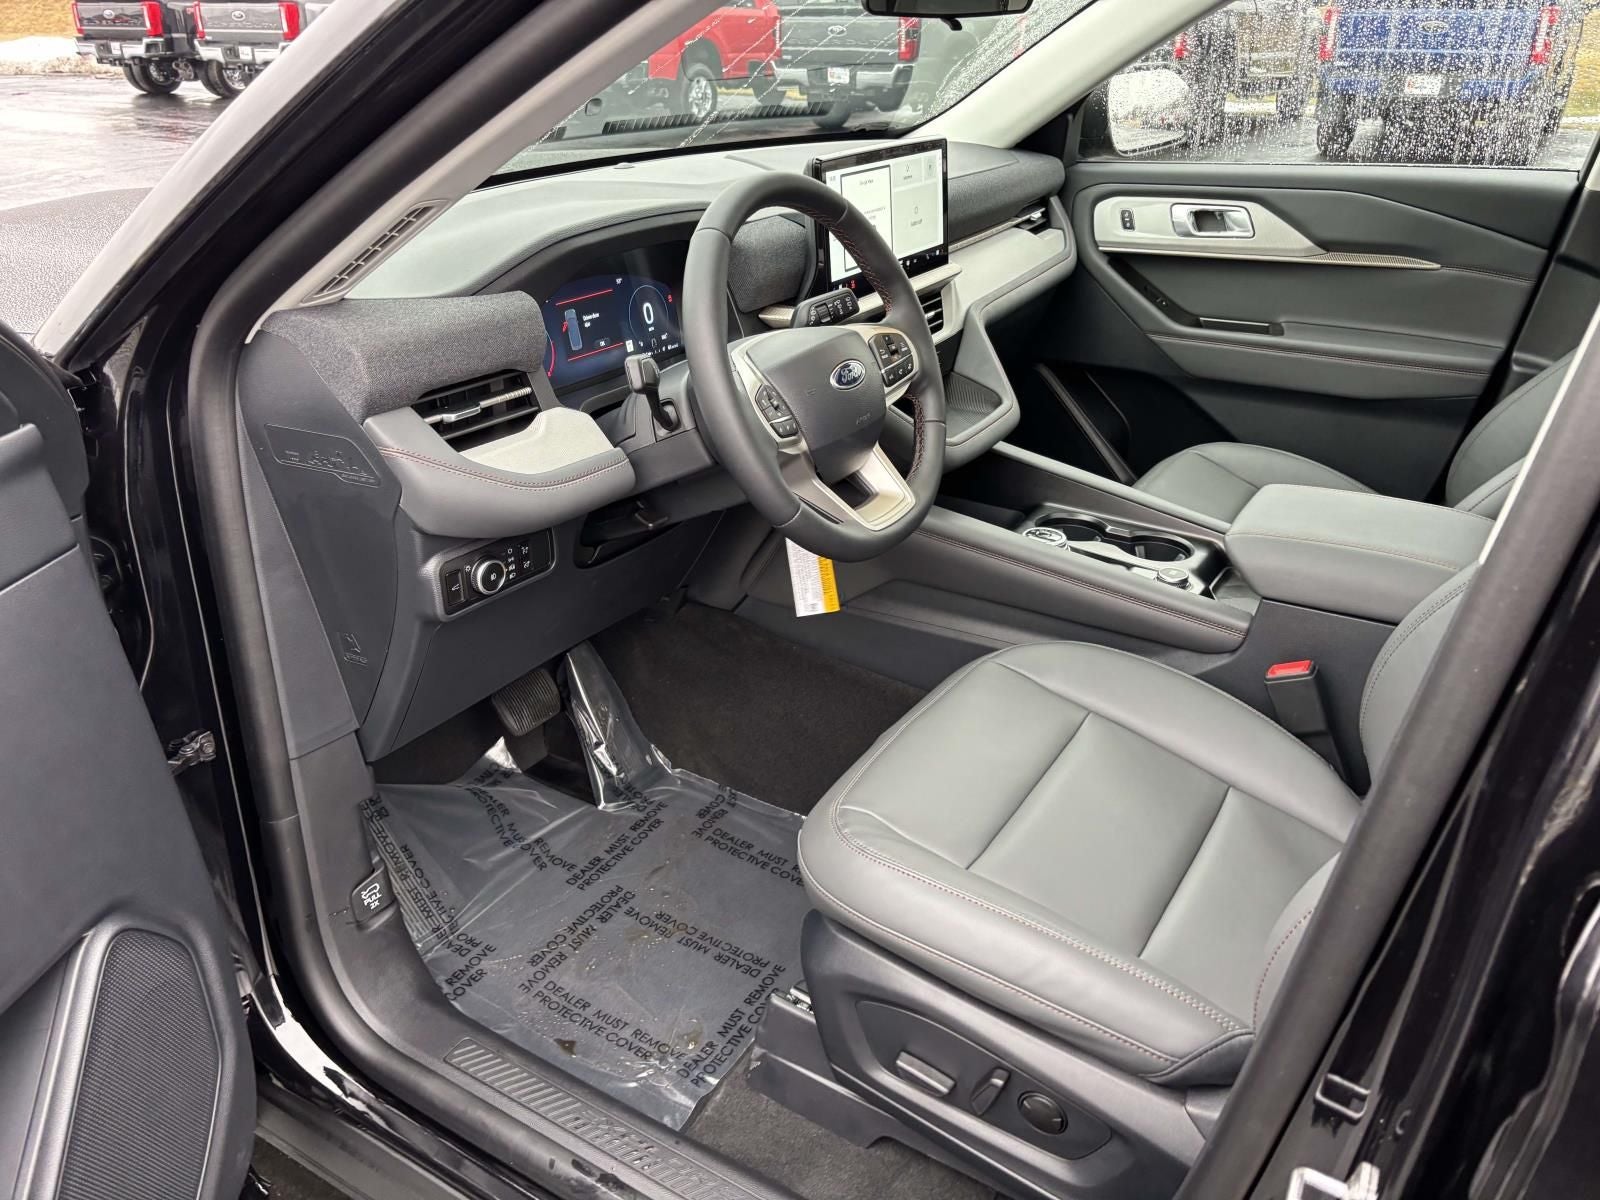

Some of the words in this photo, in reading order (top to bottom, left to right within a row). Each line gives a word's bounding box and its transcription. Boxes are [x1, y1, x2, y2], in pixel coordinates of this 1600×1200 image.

[643, 302, 654, 325] 0
[534, 837, 577, 872] REMOVE
[566, 856, 605, 886] DEALER
[603, 832, 630, 855] MUST
[629, 801, 669, 832] REMOVE
[577, 844, 635, 891] PROTECTIVE
[631, 818, 665, 846] COVER
[704, 835, 770, 870] PROTECTIVE
[770, 865, 805, 888] COVE
[712, 828, 754, 852] DEALER
[758, 849, 789, 866] MUST
[400, 844, 431, 889] COVER
[364, 892, 382, 906] PULL
[564, 884, 624, 935] PROTECTIVE
[596, 891, 636, 924] DEALER
[568, 924, 597, 951] MUST
[624, 906, 673, 939] REMOVE
[655, 911, 698, 936] COVER
[526, 934, 567, 968] COVER
[676, 936, 710, 955] MUST
[699, 931, 771, 968] PROTECTIVE
[445, 944, 497, 987] REMOVE
[518, 952, 568, 994] REMOVE
[713, 951, 762, 978] DEALER
[444, 968, 488, 1001] COVER
[532, 990, 606, 1037] PROTECTIVE
[606, 1032, 653, 1060] COVER
[543, 980, 592, 1012] DEALER
[592, 1009, 630, 1031] MUST
[630, 1028, 688, 1061] REMOVE
[676, 1040, 719, 1078] DEALER
[717, 1008, 746, 1039] MUST
[743, 964, 786, 1007] REMOVE
[690, 1024, 753, 1088] PROTECTIVE
